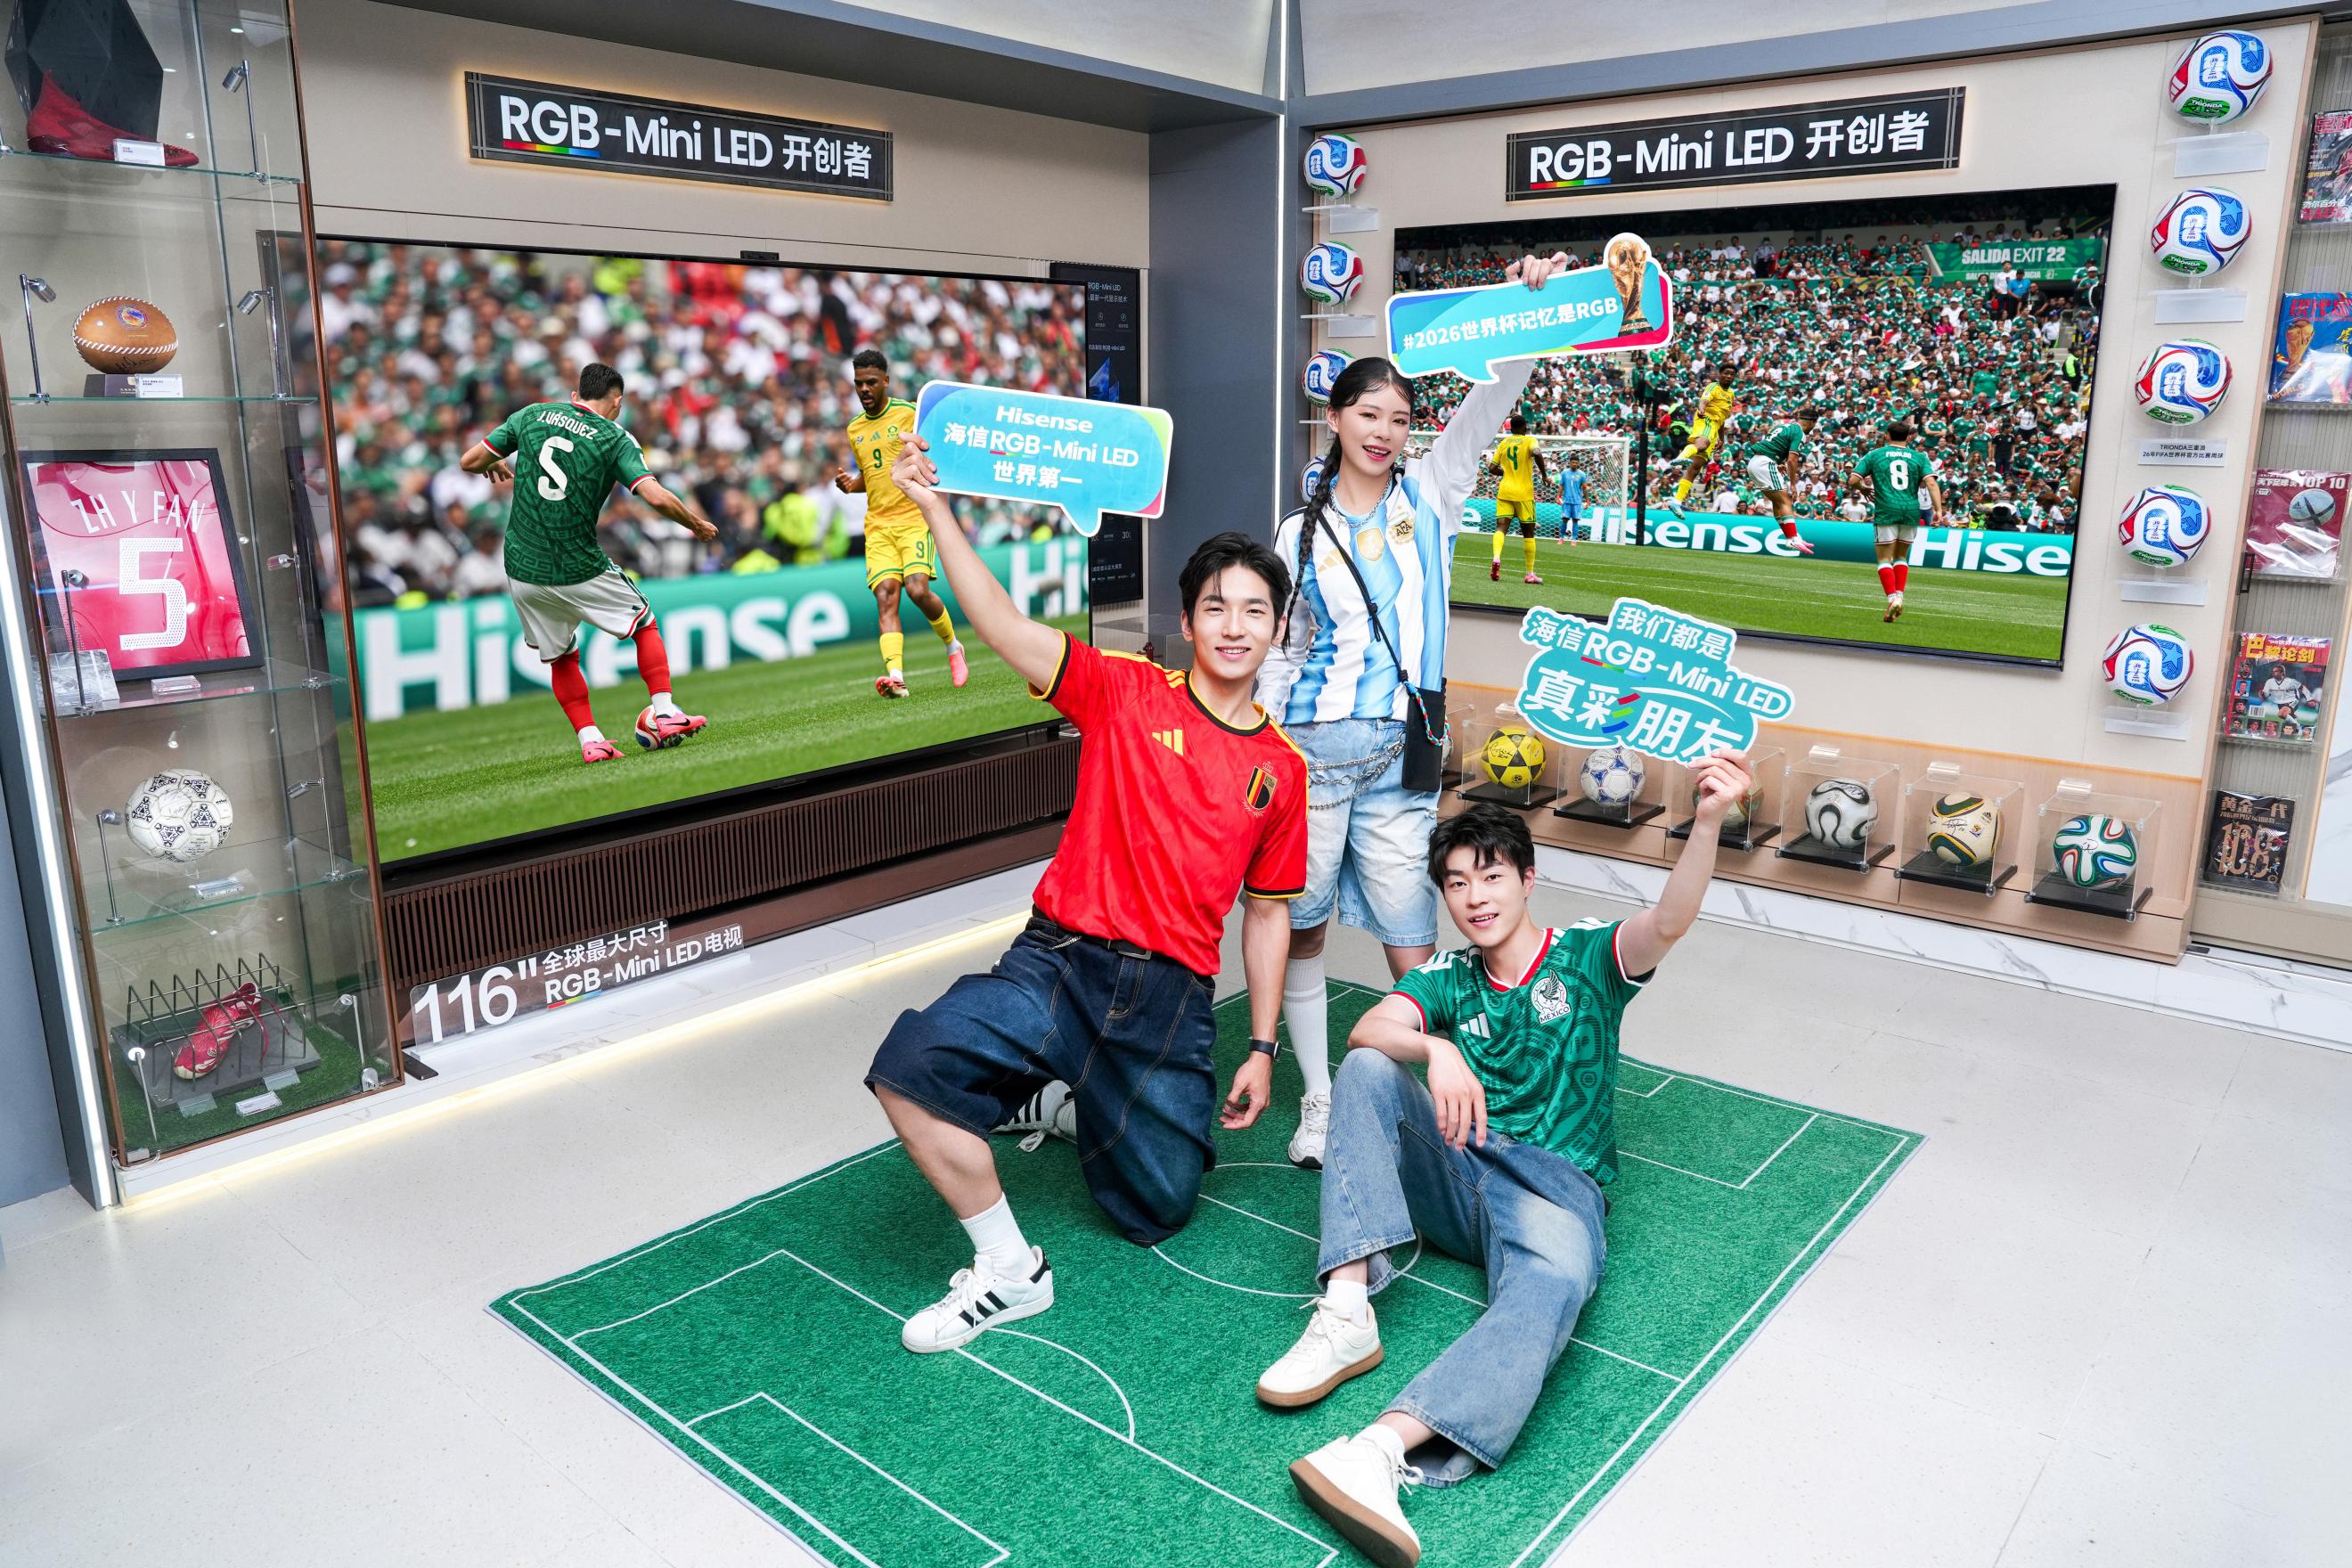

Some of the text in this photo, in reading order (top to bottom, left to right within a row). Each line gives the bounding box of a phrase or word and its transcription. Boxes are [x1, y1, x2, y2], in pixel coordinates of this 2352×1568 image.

[2191, 99, 2224, 109] TRIONDA
[500, 94, 872, 180] RGB-Mini LED 开创者
[1530, 110, 1930, 184] RGB-Mini LED 开创者
[1961, 246, 2067, 265] SALIDA EXIT 22
[2170, 256, 2201, 266] TRIONDA
[1402, 297, 1619, 351] #2026世界杯记忆是RGB
[995, 405, 1094, 434] Hisense
[872, 448, 883, 469] 9
[943, 421, 1139, 468] 海信RGB-Mini LED
[1507, 445, 1518, 471] 4
[992, 461, 1083, 489] 世界第一
[1889, 459, 1909, 491] 8
[2329, 477, 2346, 489] 10
[153, 491, 206, 534] FAN
[915, 541, 925, 559] 9
[119, 537, 187, 650] 5
[1010, 537, 1089, 619] Hi
[1616, 606, 1730, 662] 我们都是
[2245, 636, 2316, 664] 巴黎论剑
[1528, 614, 1786, 715] 海信RGB-Mini LED
[1523, 666, 1744, 759] 真彩朋友
[2221, 796, 2289, 819] 黄金一代
[541, 920, 667, 976] 全球最大尺寸
[544, 925, 743, 1005] RGB-Mini LED 电视
